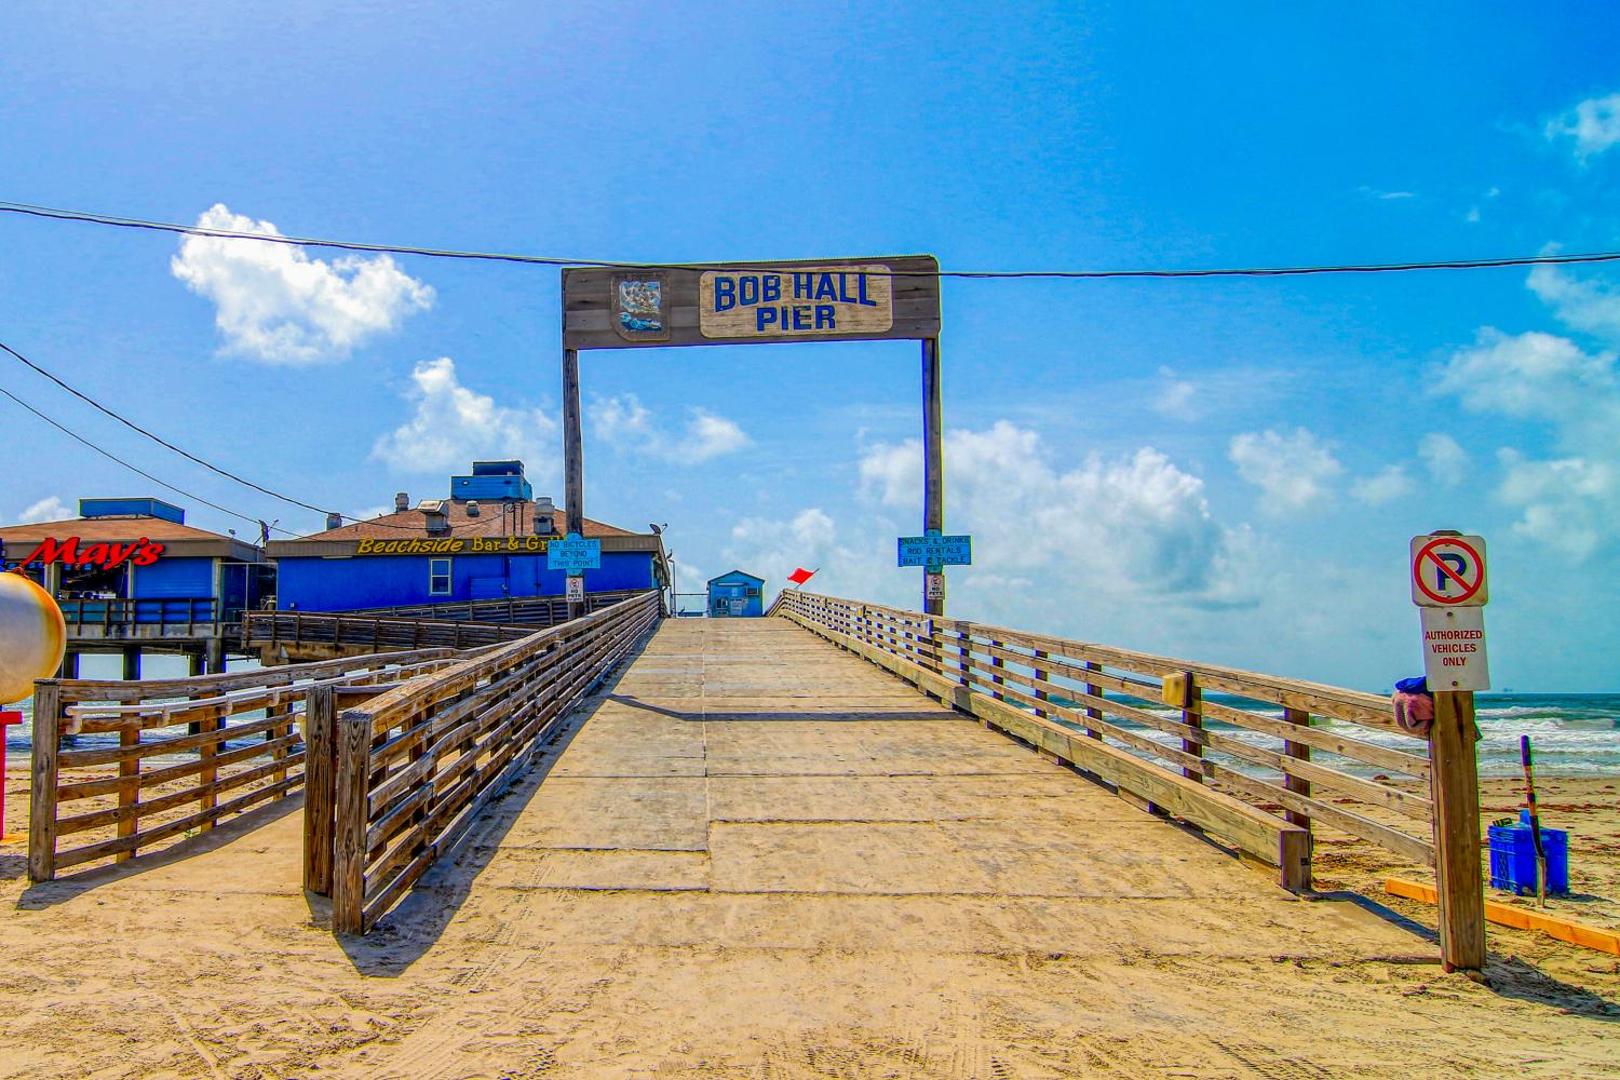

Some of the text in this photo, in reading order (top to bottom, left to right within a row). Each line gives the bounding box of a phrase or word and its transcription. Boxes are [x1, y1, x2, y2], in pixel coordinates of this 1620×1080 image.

[714, 271, 877, 313] BOB HALL
[756, 304, 836, 332] PIER
[357, 537, 464, 554] Beachside
[472, 536, 500, 551] Bar
[507, 536, 519, 551] &
[926, 546, 961, 554] RENTALS
[20, 536, 166, 571] May's
[936, 555, 965, 564] TACKLE
[1424, 629, 1483, 641] AUTHORIZED
[1431, 643, 1477, 654] VEHICLES
[1442, 656, 1467, 667] ONLY
